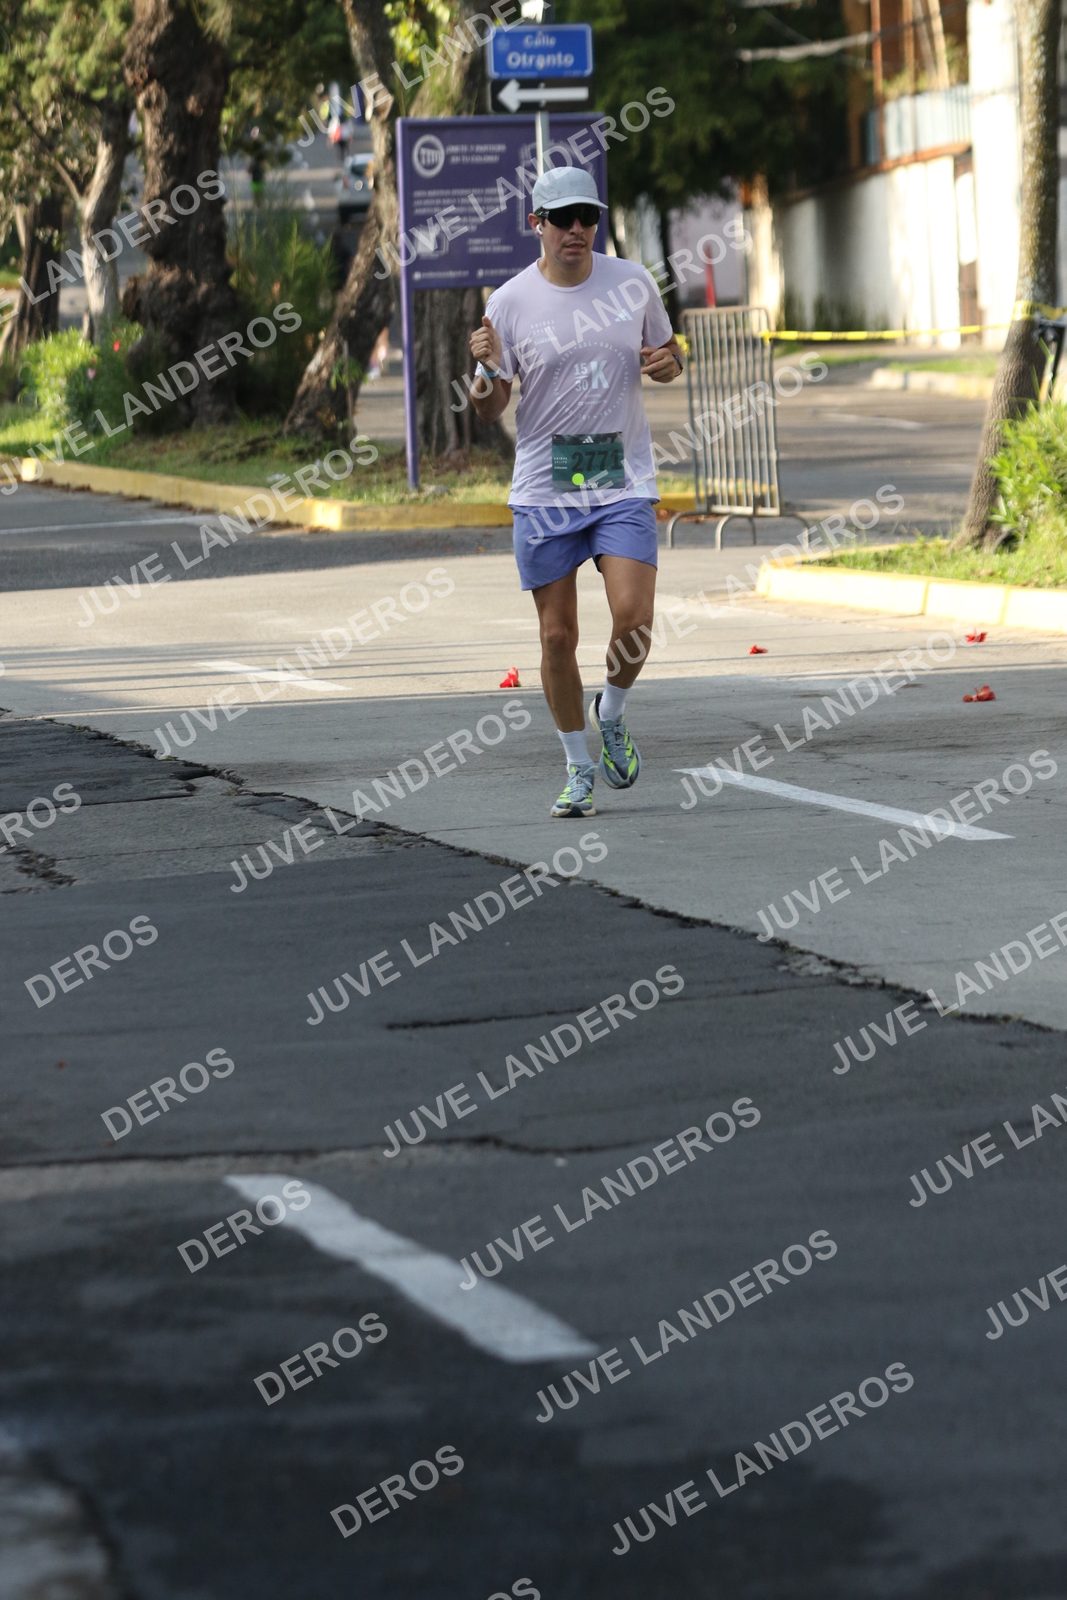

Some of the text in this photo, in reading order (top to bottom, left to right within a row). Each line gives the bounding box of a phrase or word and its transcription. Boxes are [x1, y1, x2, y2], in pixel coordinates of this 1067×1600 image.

[523, 32, 556, 49] Calle
[506, 50, 575, 70] Otranto
[574, 362, 589, 376] 15
[590, 359, 610, 389] K
[571, 449, 624, 472] 2771
